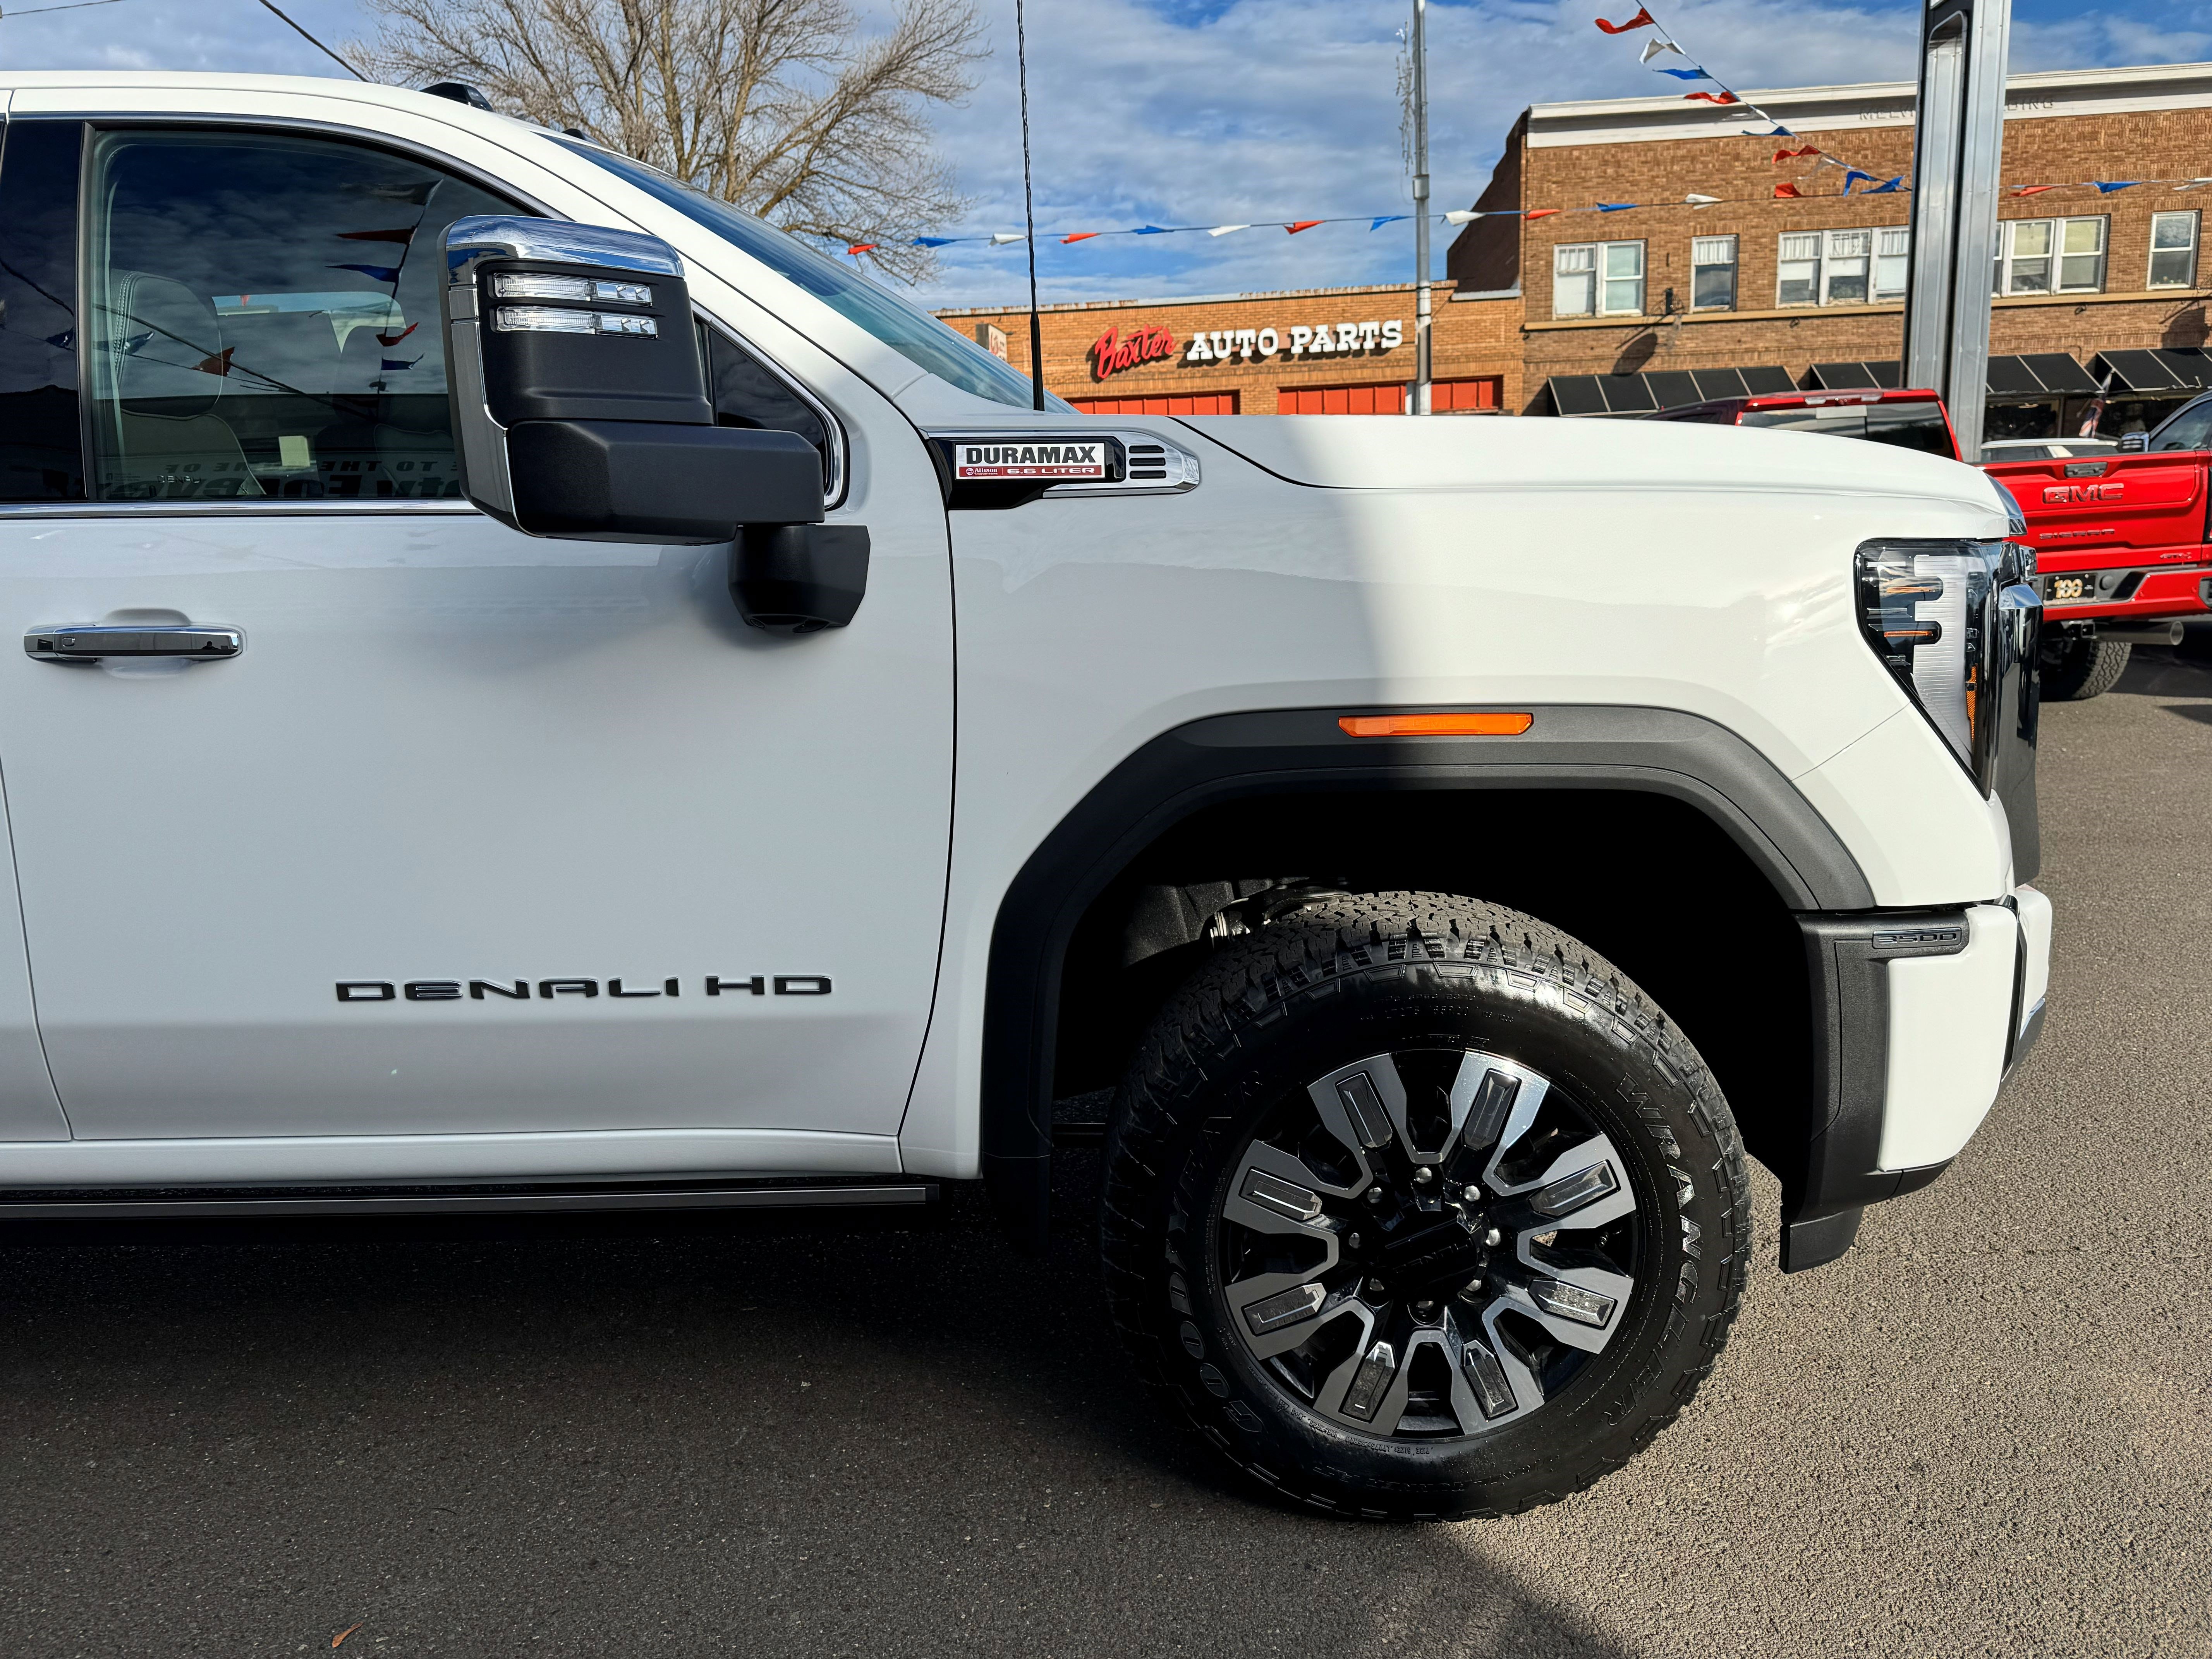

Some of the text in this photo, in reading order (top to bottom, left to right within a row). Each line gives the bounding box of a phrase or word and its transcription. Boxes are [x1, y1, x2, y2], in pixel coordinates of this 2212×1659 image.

[1095, 320, 1403, 379] Baxter AUTO PARTS
[966, 446, 1096, 464] DURAMAX
[156, 475, 201, 484] DENALI
[2043, 483, 2124, 504] GMC
[2039, 529, 2115, 539] SIERRA
[336, 974, 832, 1002] DENALI HD
[1603, 1072, 1703, 1427] WRANGLER
